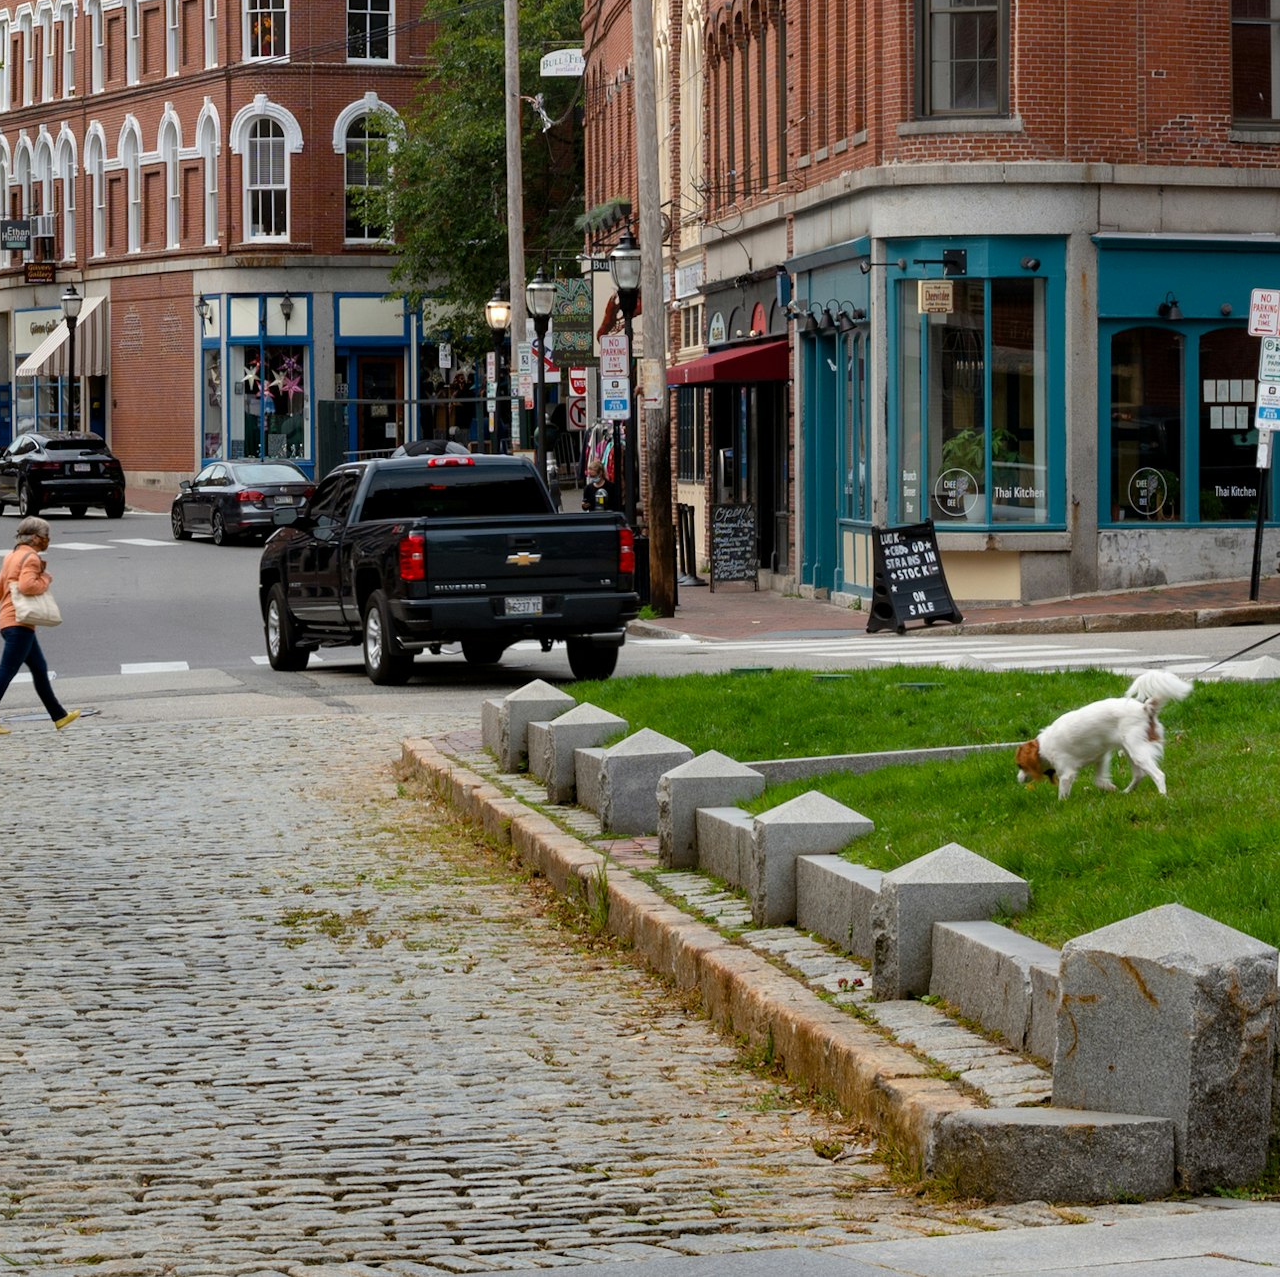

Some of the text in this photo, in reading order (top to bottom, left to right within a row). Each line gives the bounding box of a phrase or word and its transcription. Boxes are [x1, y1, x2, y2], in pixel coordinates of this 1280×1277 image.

[7, 227, 30, 236] Ethan
[1, 232, 28, 242] Hunter
[1260, 294, 1272, 303] NO
[1253, 304, 1278, 314] PARKING
[609, 339, 619, 347] NO
[603, 348, 626, 356] PARKING
[903, 470, 917, 482] Brunch
[943, 480, 957, 489] CHEE
[1135, 479, 1147, 488] CHEE
[904, 486, 916, 498] Dinner
[995, 486, 1045, 498] Thai Kitchen
[1215, 486, 1257, 497] Thai Kitchen
[947, 499, 956, 507] DEE
[885, 551, 936, 570] STRAINS IN
[434, 583, 487, 591] SILVERADO
[912, 590, 926, 602] ON
[909, 602, 935, 615] SALE
